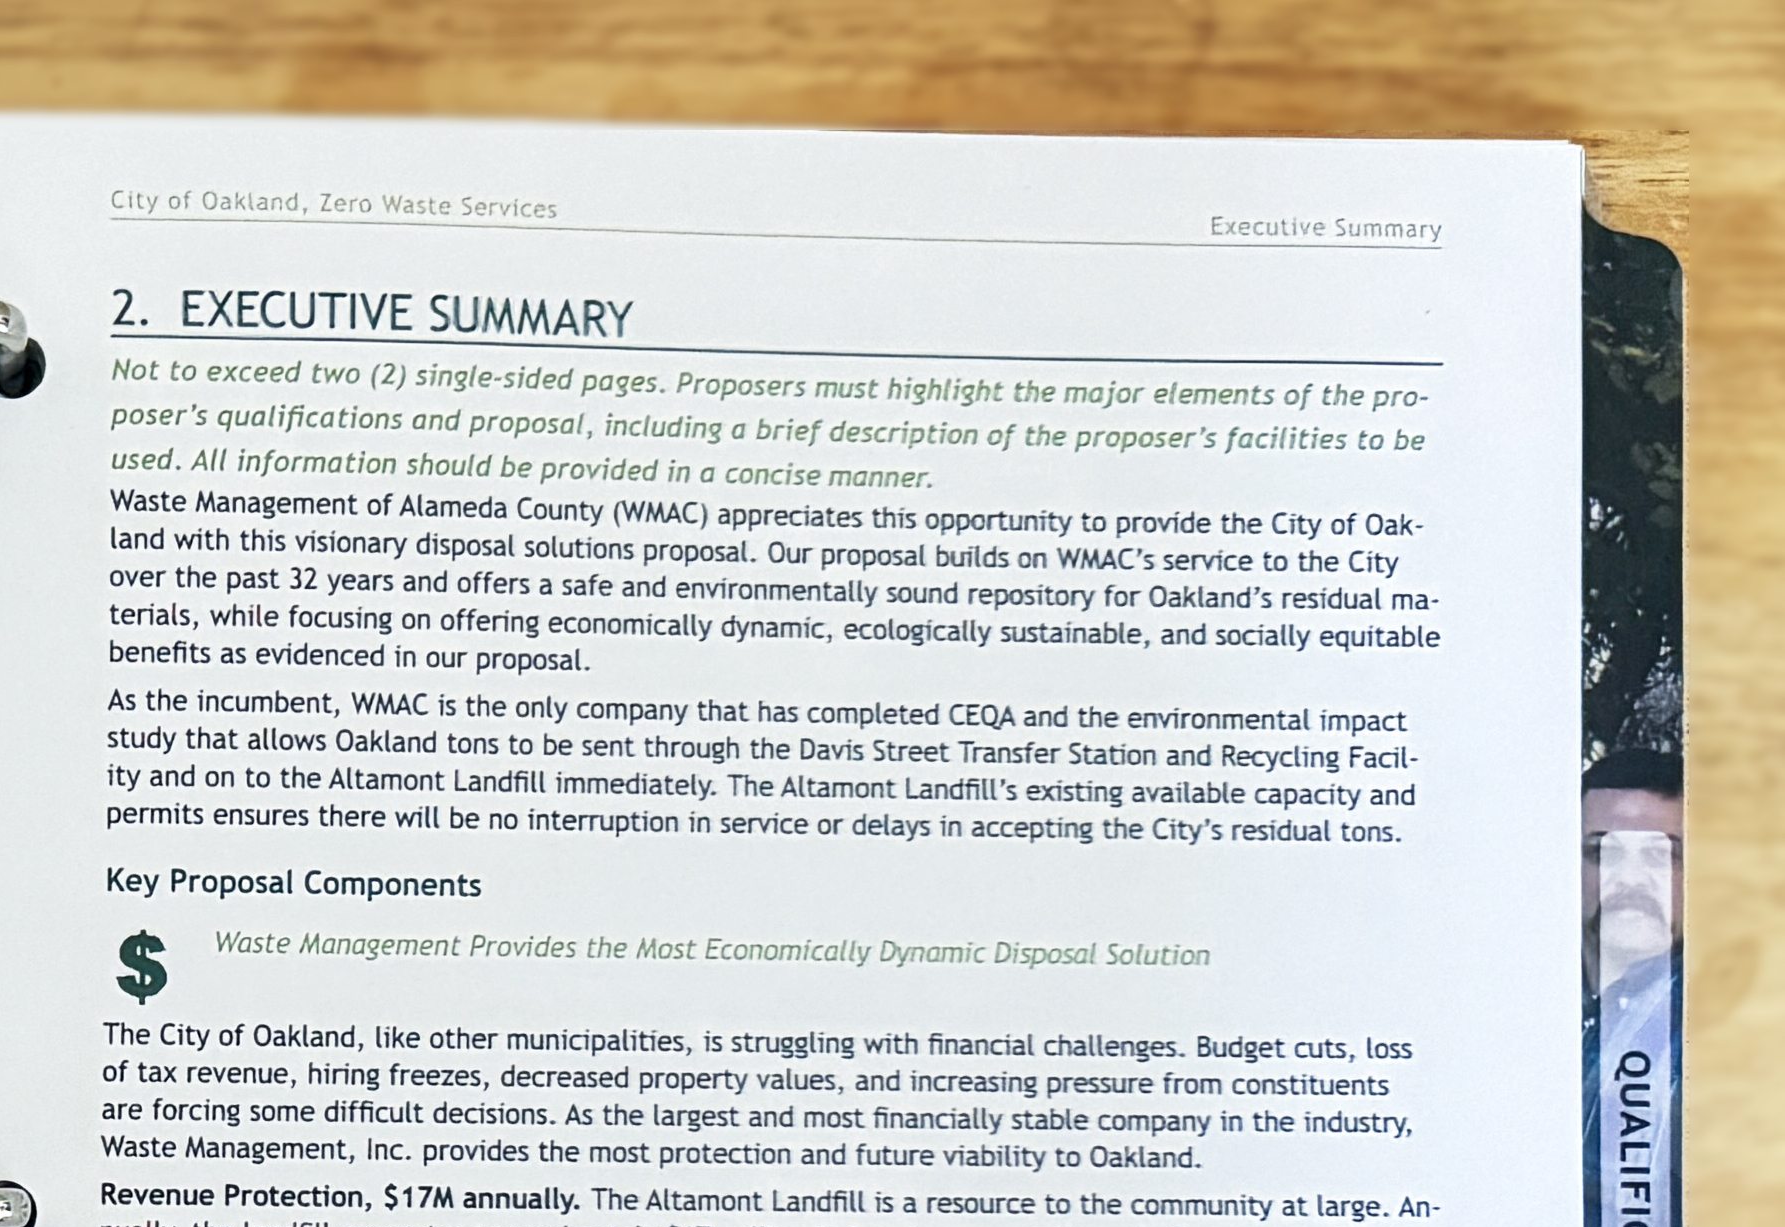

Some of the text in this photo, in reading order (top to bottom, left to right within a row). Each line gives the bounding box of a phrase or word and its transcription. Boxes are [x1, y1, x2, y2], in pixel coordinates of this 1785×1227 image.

[110, 189, 558, 219] City of Oakland, Zero Waste Services
[1211, 215, 1443, 243] Executive Summary
[112, 287, 635, 339] 2. EXECUTIVE SUMMARY
[111, 357, 1429, 413] Not to exceed two (2) single-sided pages. Proposers must highlight the major elements of the pro-
[111, 446, 934, 489] used. All information should be provided in a concise manner.
[109, 488, 1425, 541] Waste Management of Alameda County (WMAC) appreciates this opportunity to provide the City of Oak-
[106, 866, 482, 903] Key Proposal Components
[215, 930, 1211, 970] Waste Management Provides the Most Economically Dynamic Disposal Solution
[100, 1181, 1442, 1224] Revenue Protection, $17M annually. The Altamont Landfill is a resource to the community at large. An-
